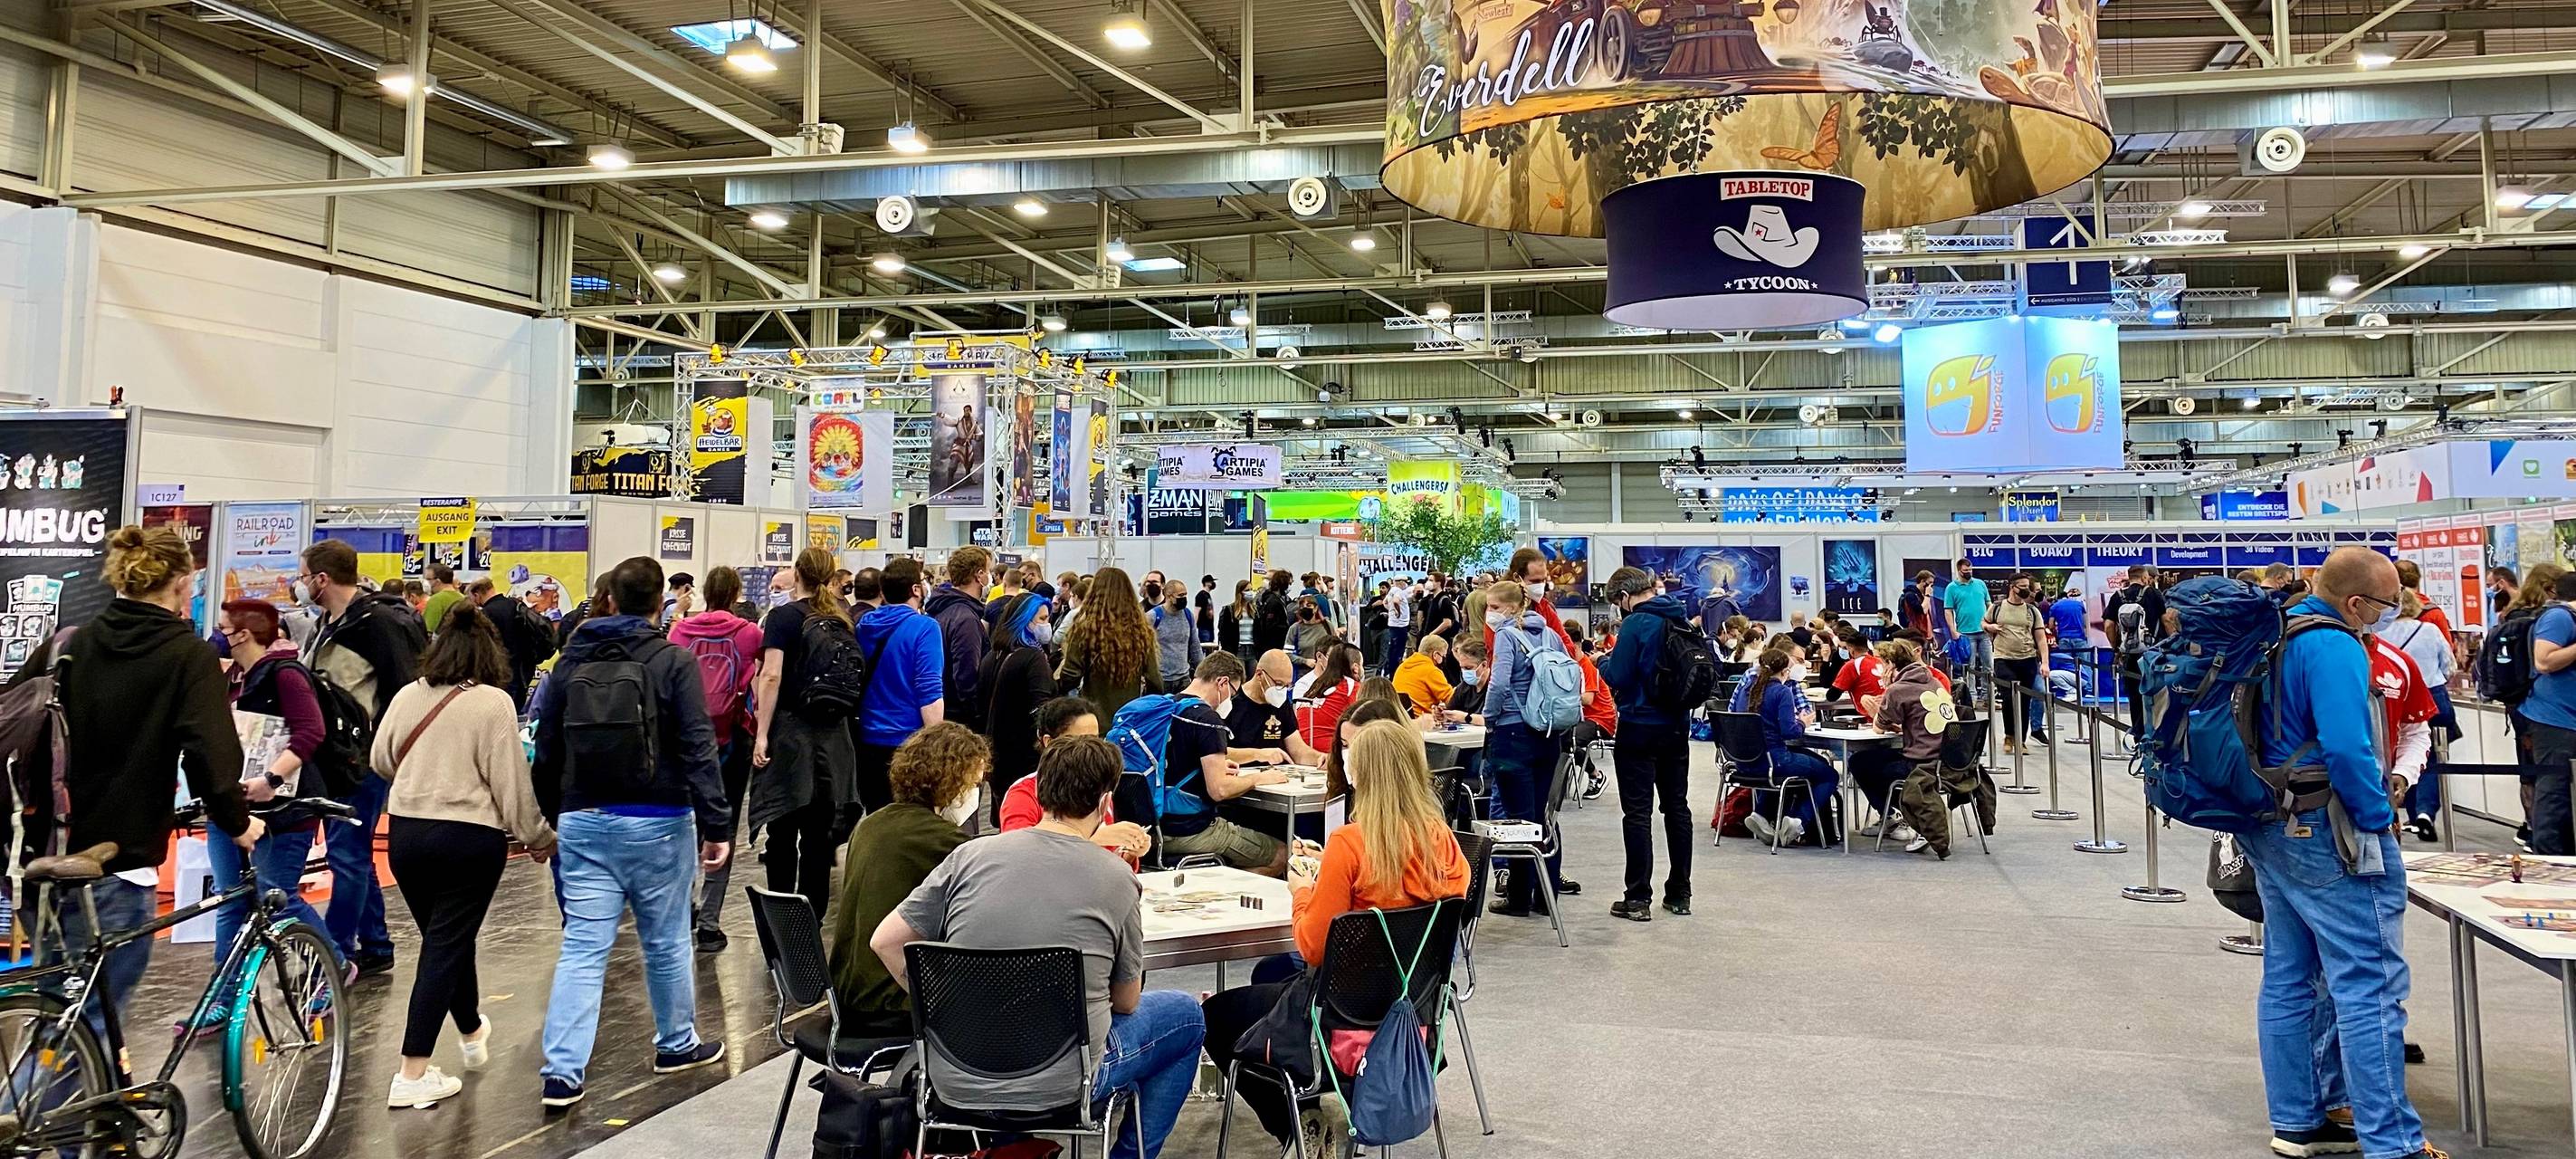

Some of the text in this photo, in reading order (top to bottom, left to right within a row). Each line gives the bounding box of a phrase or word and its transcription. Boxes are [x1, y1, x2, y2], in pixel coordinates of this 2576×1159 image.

[1475, 5, 1512, 20] Newleaf
[1417, 18, 1595, 138] Everdell
[1724, 181, 1810, 197] TABLETOP
[1733, 276, 1810, 291] TYCOON
[813, 392, 862, 406] COATL
[1987, 369, 2004, 434] FUNFORGE
[2094, 371, 2105, 434] FUNFORGE
[698, 436, 740, 447] HEIDELBÄR
[1159, 456, 1183, 467] RTIPIA
[1222, 456, 1266, 467] ARTIPIA
[1226, 467, 1264, 477] GAMES
[586, 473, 609, 491] FORGE
[613, 473, 655, 492] TITAN
[1390, 480, 1449, 495] CHALLENGERS!
[151, 493, 177, 502] 1C127
[2008, 494, 2057, 510] Splendor
[1149, 510, 1203, 519] games
[2021, 505, 2044, 514] Duel
[425, 512, 469, 522] AUSGANG
[0, 507, 106, 544] MBUG
[236, 517, 294, 531] RAILROAD
[179, 525, 204, 541] ING
[436, 526, 458, 535] EXIT
[669, 529, 687, 539] KASSE
[253, 528, 281, 548] ink
[772, 533, 787, 542] KASSE
[662, 541, 692, 552] CHECKOUT
[767, 545, 792, 555] CHECKOUT
[2096, 547, 2143, 557] THEORY
[1973, 547, 1994, 558] BIG
[2030, 547, 2073, 558] BOARD
[2171, 550, 2209, 560] Development
[1842, 598, 1862, 610] ICE
